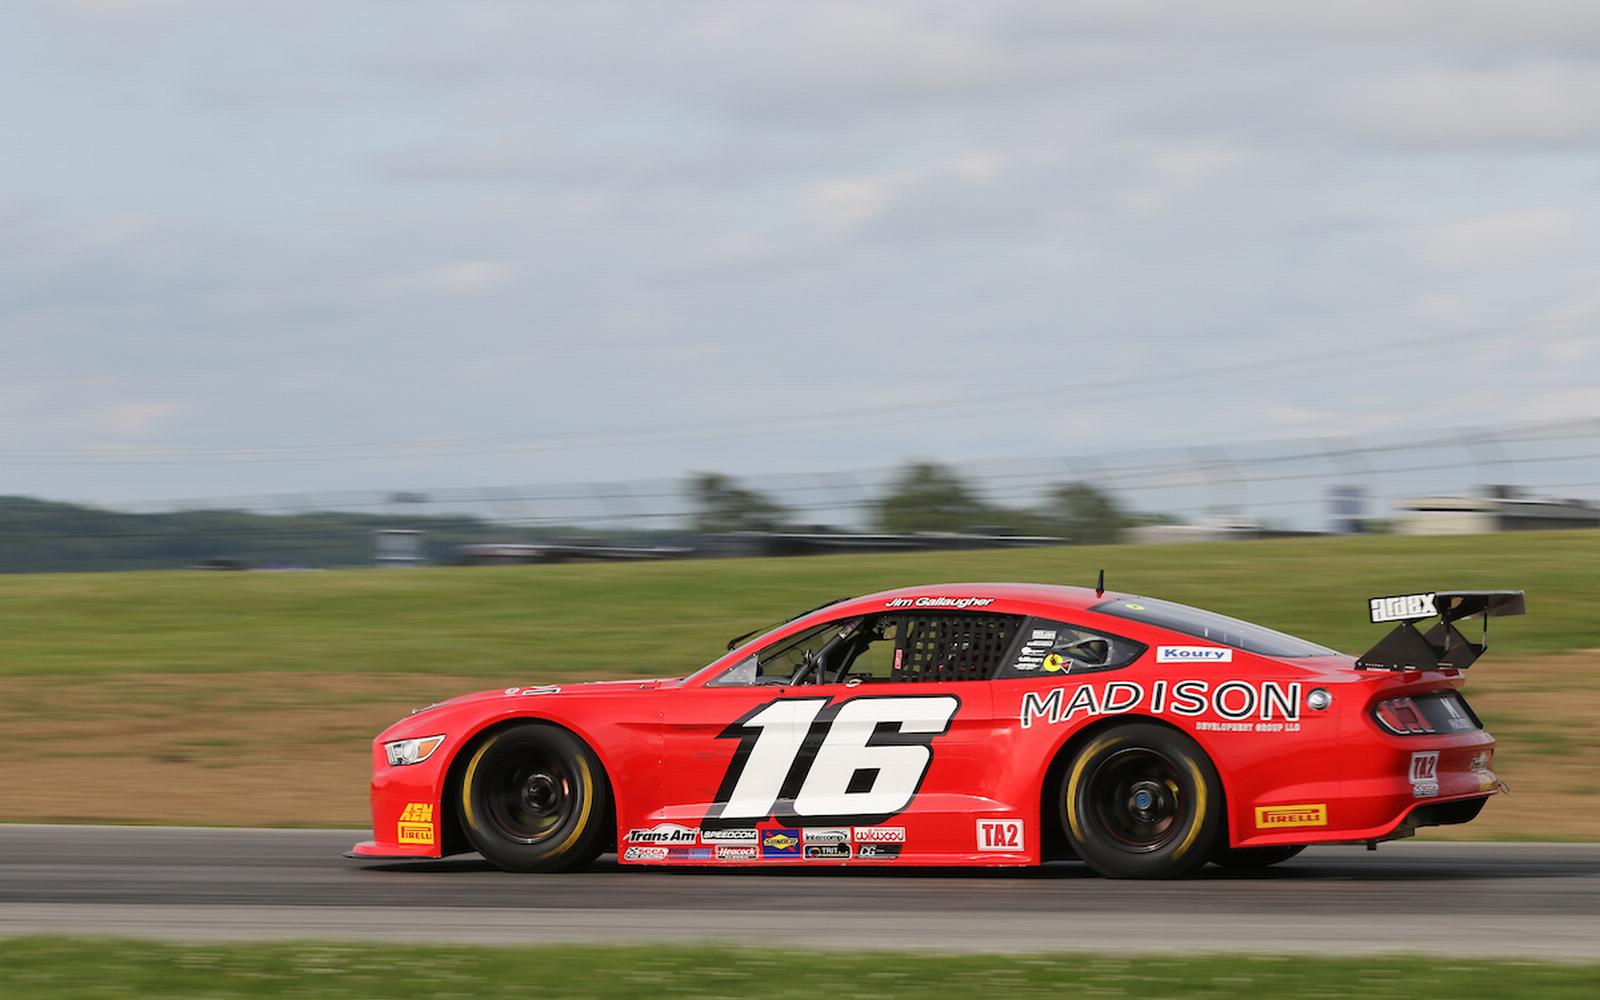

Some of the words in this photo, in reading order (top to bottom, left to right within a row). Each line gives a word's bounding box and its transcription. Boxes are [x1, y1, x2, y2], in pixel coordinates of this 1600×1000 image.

[885, 598, 913, 607] Jim
[915, 597, 995, 609] Gallaugher
[1371, 594, 1438, 621] ardex
[1164, 648, 1225, 660] Koury
[1020, 680, 1302, 729] MADISON
[1195, 722, 1254, 732] DEVELOPMENT
[717, 696, 960, 821] 16
[1413, 756, 1436, 779] TA2
[1262, 809, 1320, 824] PIRELLI
[401, 826, 432, 840] PIRELLI
[629, 830, 669, 842] Trans
[669, 829, 696, 841] Am
[702, 830, 757, 840] SPEEDCOM
[981, 823, 1019, 847] TA2
